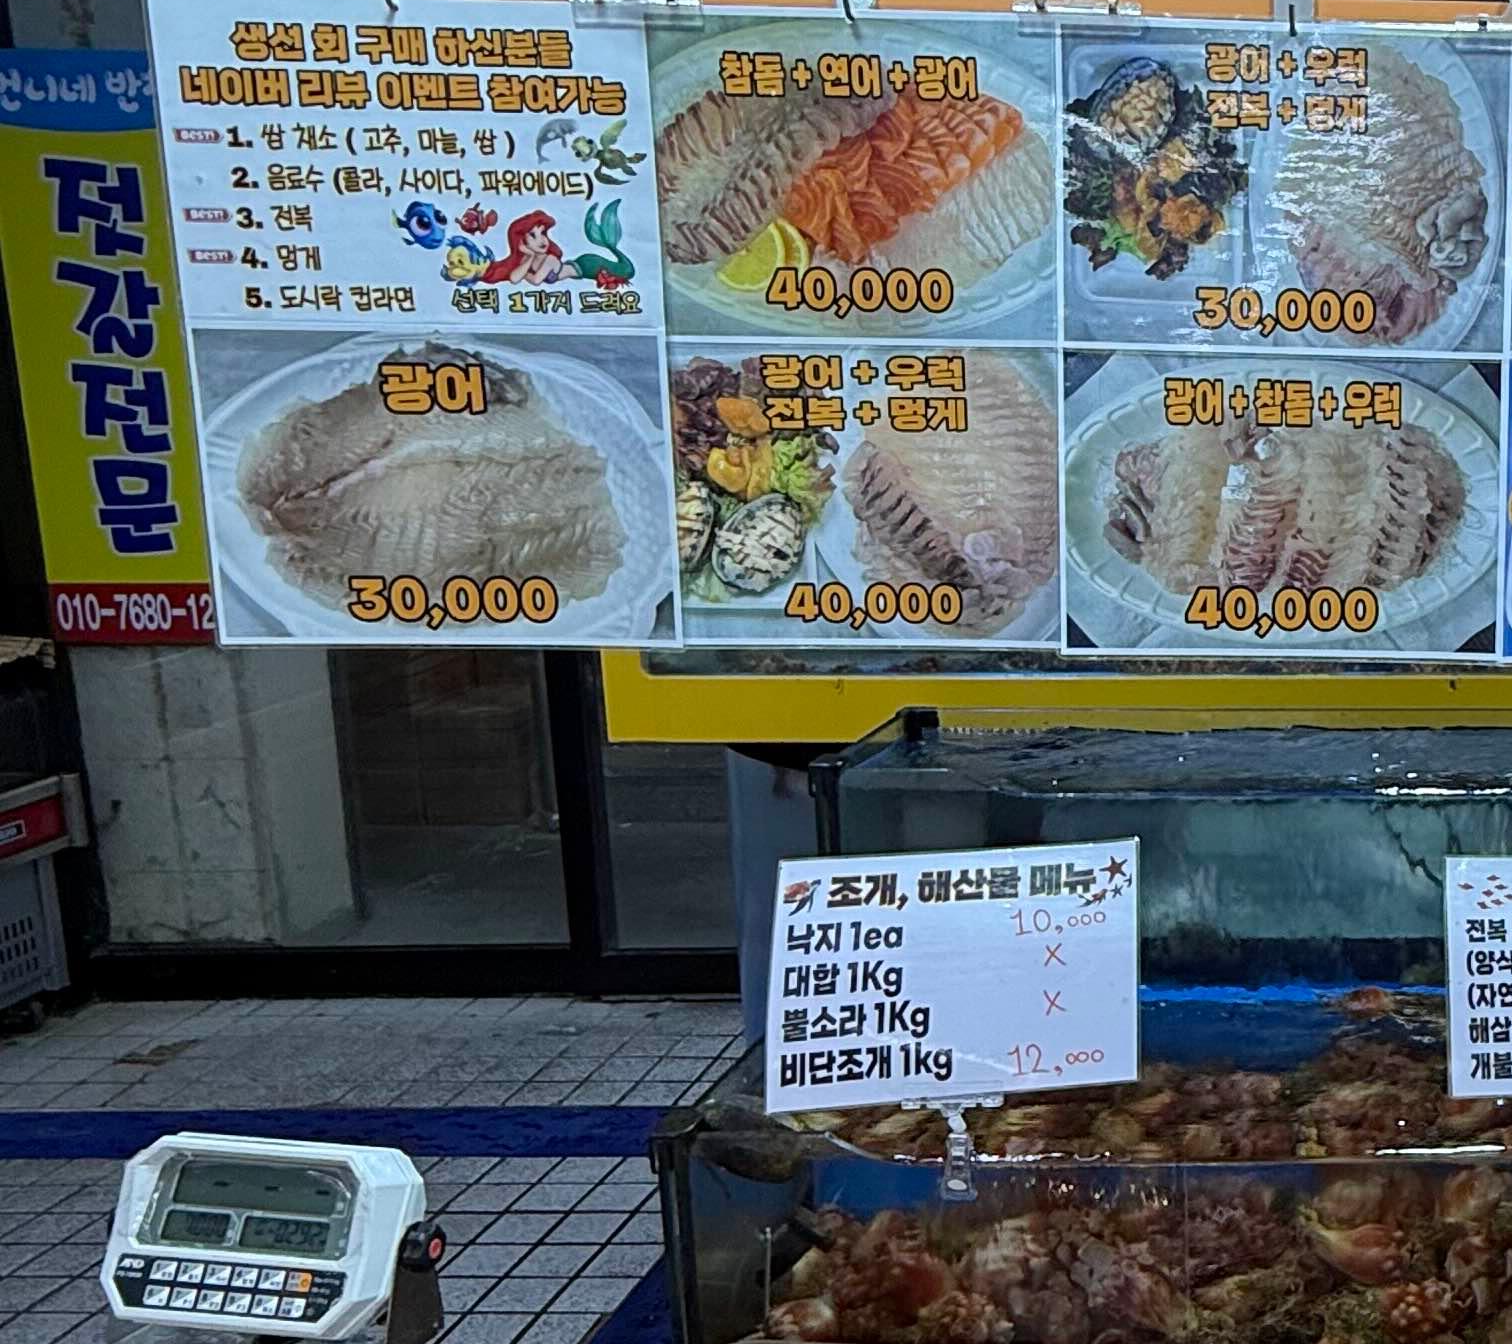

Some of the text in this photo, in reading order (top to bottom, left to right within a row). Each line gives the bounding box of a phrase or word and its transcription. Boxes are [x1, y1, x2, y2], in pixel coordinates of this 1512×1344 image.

[230, 21, 573, 69] 생선 회 구매 하신분들
[178, 66, 627, 115] 네이버 리뷰 이벤트 참여가능
[294, 122, 338, 153] 채소
[267, 163, 325, 193] 음료수
[399, 169, 472, 198] 사이다,
[270, 204, 315, 233] 전복
[276, 245, 322, 273] 멍게
[279, 285, 418, 314] 도시락 컵라면
[451, 288, 501, 314] 선택
[579, 291, 644, 317] 드려요
[765, 267, 954, 318] 40,000
[1193, 287, 1377, 336] 30,000
[378, 361, 488, 415] 광어
[347, 576, 558, 629] 30,000
[785, 582, 962, 630] 40,000
[1185, 586, 1379, 637] 40,000
[917, 865, 1021, 904] 해산물
[1029, 863, 1098, 897] 메뉴
[786, 921, 842, 955] 낙지
[850, 922, 904, 951] 1ea
[1465, 917, 1508, 943] 전복
[783, 964, 840, 998] 대합
[1468, 1016, 1511, 1044] 해삼
[779, 1044, 893, 1089] 비단조개
[1470, 1052, 1512, 1080] 개불
